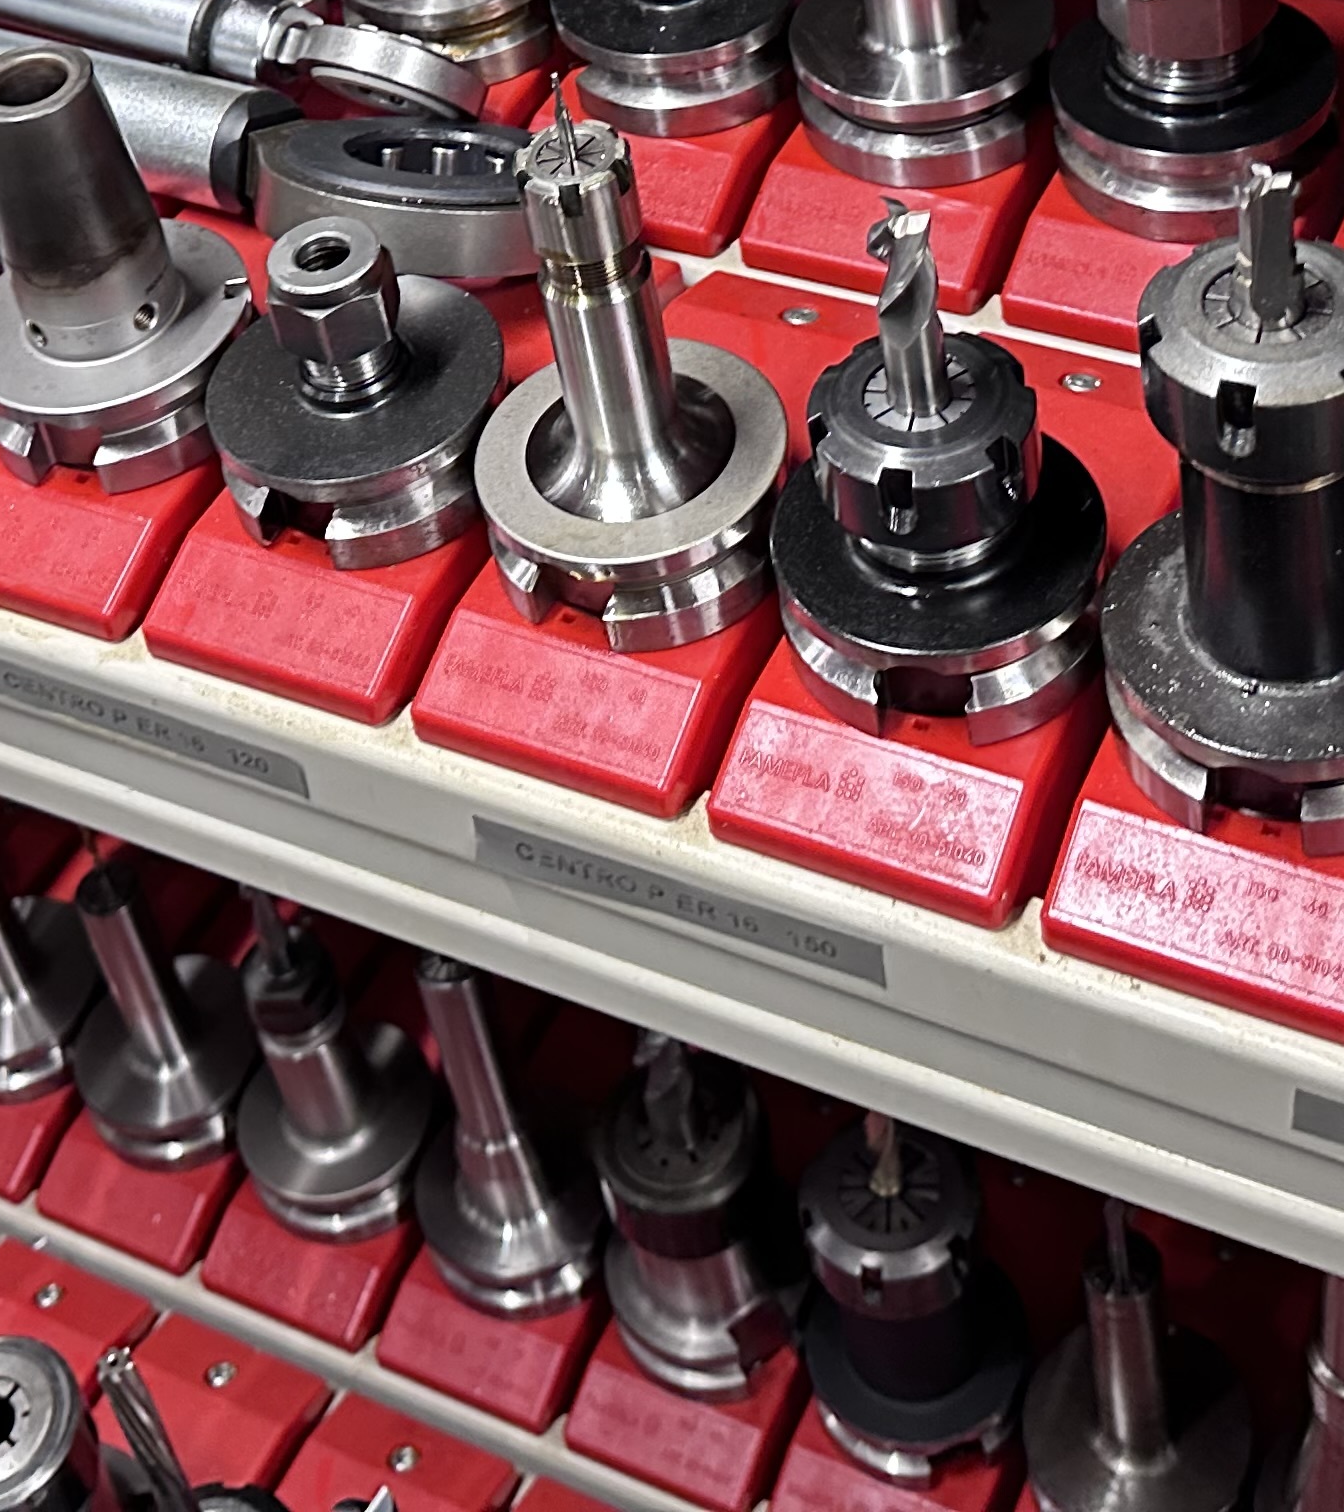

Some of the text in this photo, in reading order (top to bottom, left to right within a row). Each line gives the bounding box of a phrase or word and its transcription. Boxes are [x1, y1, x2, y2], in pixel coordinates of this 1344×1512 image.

[3, 670, 104, 719] CENTRO
[111, 707, 127, 726] P
[136, 716, 172, 742] ER
[514, 841, 637, 896] CENTRO
[646, 882, 665, 900] P
[676, 894, 718, 920] ER
